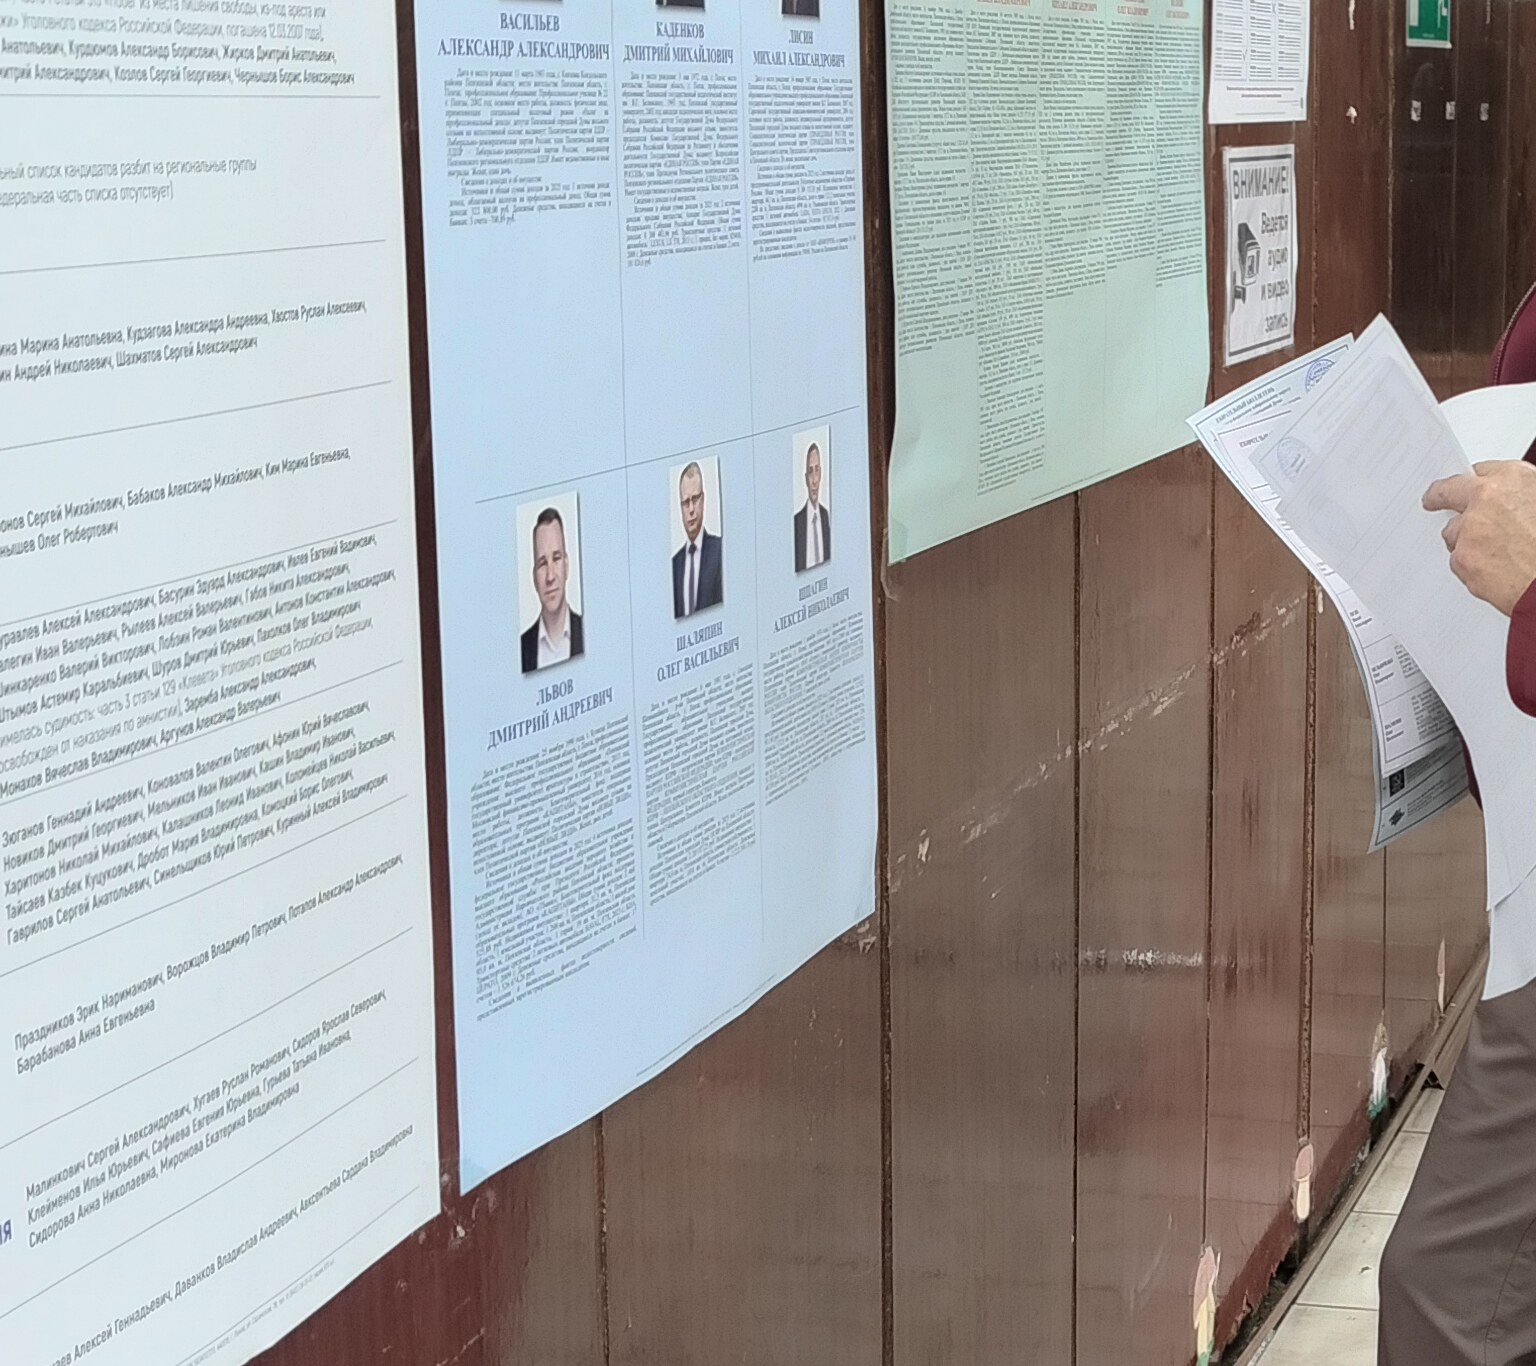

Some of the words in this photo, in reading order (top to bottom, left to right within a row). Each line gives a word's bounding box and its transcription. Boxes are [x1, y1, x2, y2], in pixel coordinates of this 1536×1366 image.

[500, 12, 560, 32] ВАСИЛЬЕВ
[655, 21, 705, 39] КАДЕНКОВ
[437, 38, 515, 61] АЛЕКСАНДР
[516, 41, 610, 61] АЛЕКСАНДРОВИЧ
[622, 42, 670, 63] ДМИТРИЙ
[672, 43, 734, 64] МИХАЙЛОВИЧ
[788, 51, 845, 68] АЛЕКСАНДРОВИЧ
[1233, 166, 1289, 199] ВНИМАНИЕ!
[1261, 212, 1288, 236] Ведется
[1267, 247, 1288, 272] аудио
[1261, 285, 1266, 301] и
[1267, 279, 1289, 302] видео
[20, 338, 59, 353] Марина
[62, 331, 124, 348] Анатольевна,
[773, 604, 806, 633] АЛЕКСЕЙ
[676, 621, 723, 652] ШАЛЯПИН
[656, 658, 683, 682] ОЛЕГ
[684, 636, 740, 672] ВАСИЛЬЕВИЧ
[536, 678, 574, 706] ЛЬВОВ
[487, 709, 550, 751] ДМИТРИЙ
[552, 687, 614, 726] АНДРЕЕВИЧ
[2, 822, 44, 847] Зюганов
[46, 801, 92, 829] Геннадий
[94, 787, 145, 812] Андреевич,
[147, 768, 194, 793] Коновалов
[14, 1013, 75, 1049] Праздников
[76, 1001, 100, 1022] Эрик
[102, 973, 164, 1008] Нариманович,
[166, 951, 210, 979] Ворожцов
[211, 931, 250, 958] Владимир
[252, 913, 287, 938] Петрович,
[16, 1037, 76, 1073] Барабанова
[78, 1024, 101, 1044] Анна
[103, 999, 155, 1032] Евгеньевна
[26, 1160, 85, 1200] Малинкович
[87, 1137, 120, 1166] Сергей
[122, 1104, 190, 1148] Александрович,
[222, 1070, 249, 1094] Руслан
[250, 1047, 291, 1077] Романович,
[28, 1186, 81, 1223] Клейменов
[83, 1171, 106, 1192] Илья
[107, 1149, 150, 1178] Юрьевич,
[151, 1125, 190, 1154] Сафиева
[192, 1106, 225, 1132] Евгения
[29, 1212, 76, 1246] Сидорова
[76, 1198, 101, 1219] Анна
[102, 1166, 158, 1205] Николаевна,
[160, 1140, 204, 1172] Миронова
[205, 1115, 246, 1147] Екатерина
[247, 1082, 300, 1122] Владимировна
[74, 1324, 113, 1360] Алексей
[114, 1291, 173, 1333] Геннадьевич,
[174, 1263, 216, 1298] Даванков
[216, 1235, 258, 1269] Владислав
[258, 1207, 298, 1240] Андреевич,
